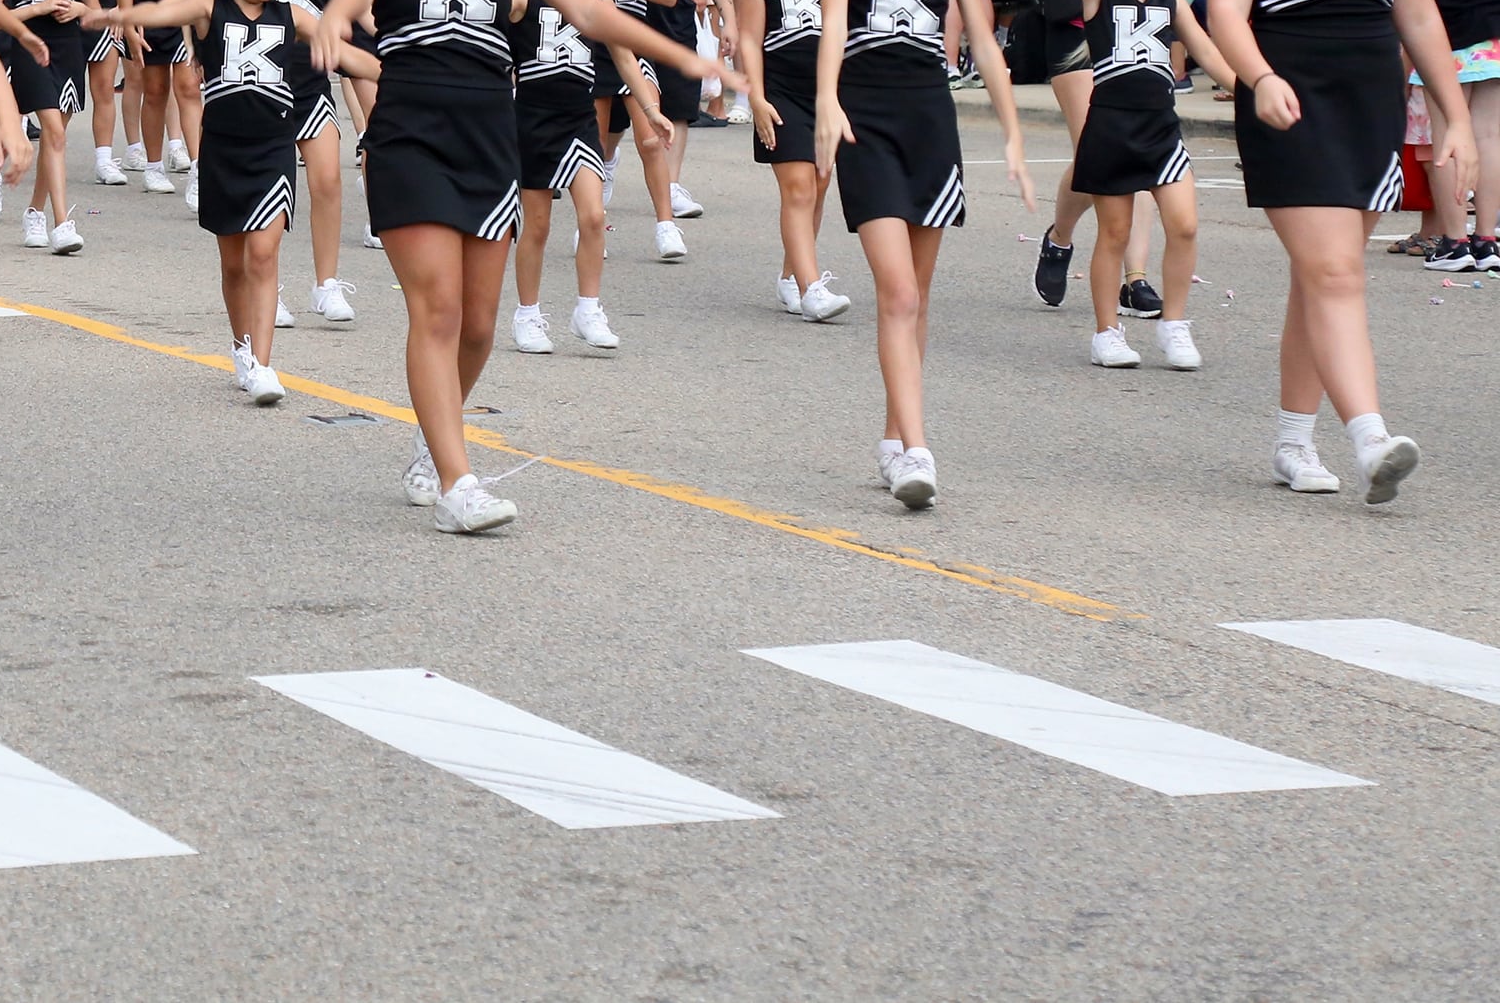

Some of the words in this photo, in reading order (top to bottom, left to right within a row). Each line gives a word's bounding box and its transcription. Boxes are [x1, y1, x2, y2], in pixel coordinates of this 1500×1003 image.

[221, 22, 285, 84] K
[536, 6, 592, 65] K
[1112, 5, 1171, 65] K
